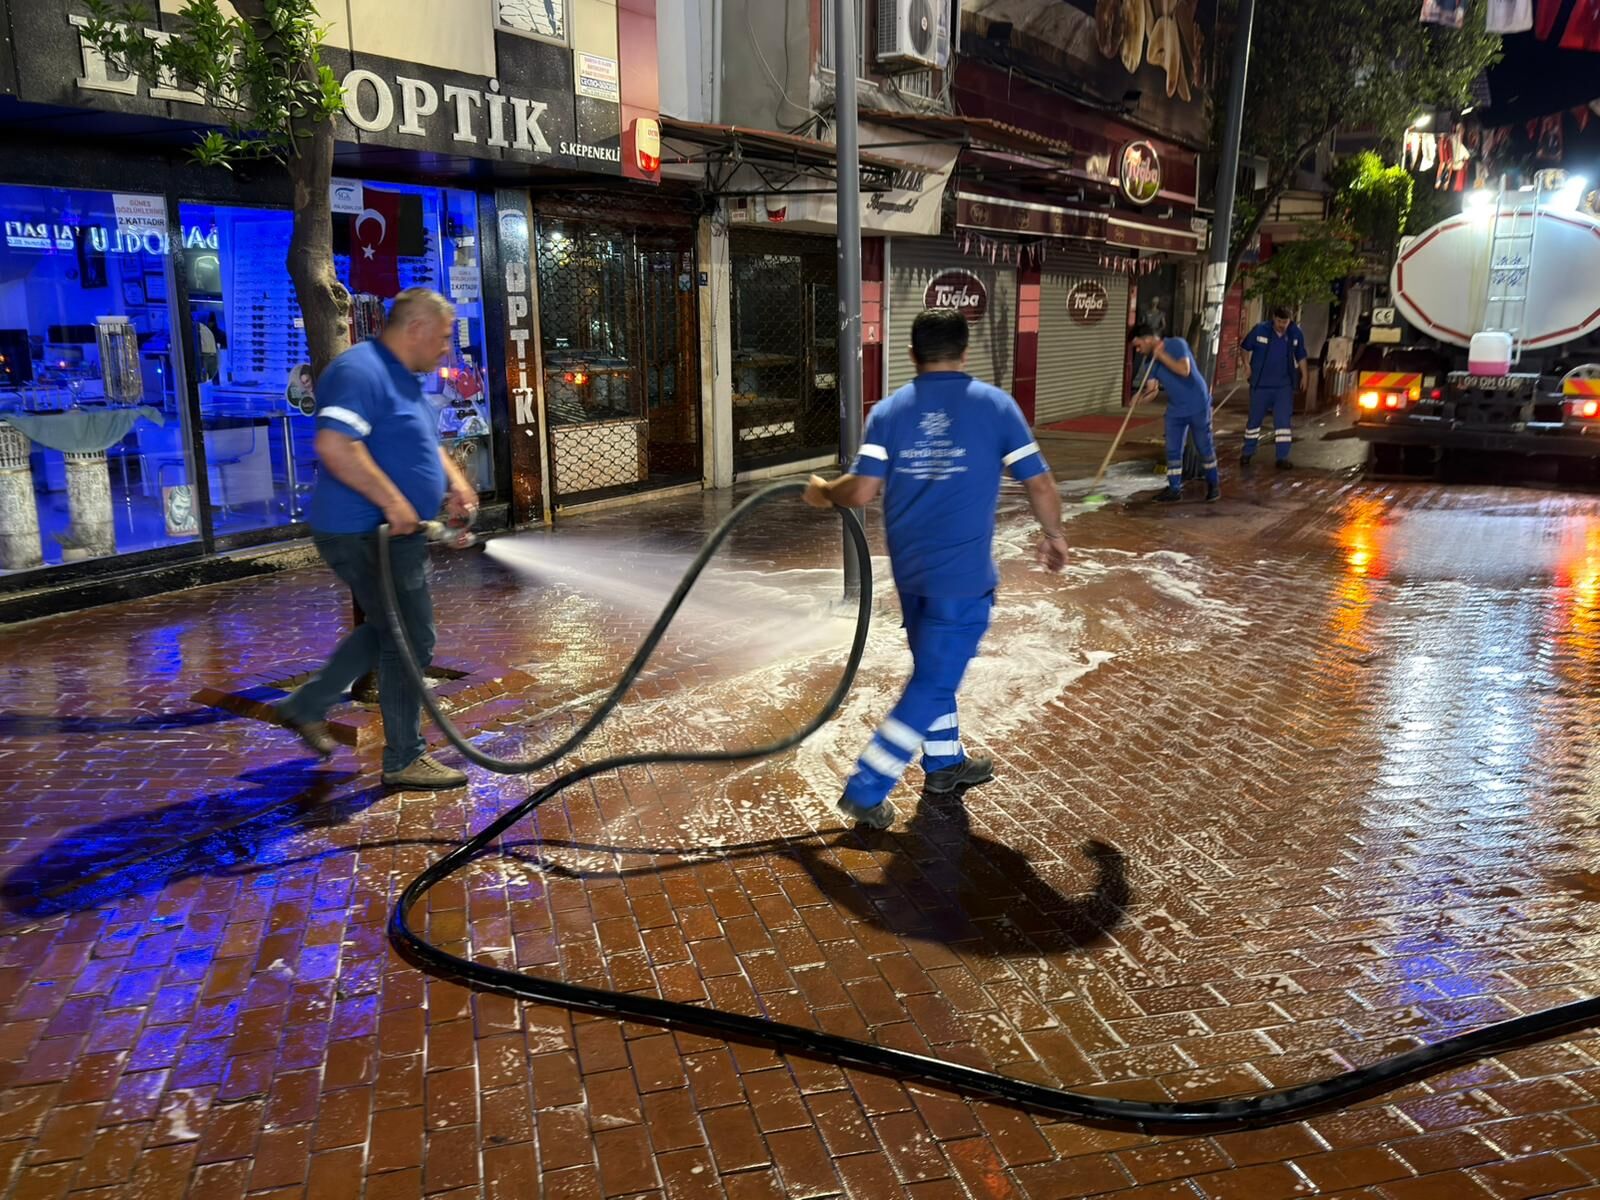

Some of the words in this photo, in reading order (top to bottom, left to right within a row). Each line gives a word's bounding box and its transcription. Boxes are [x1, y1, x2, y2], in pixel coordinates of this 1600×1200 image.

[342, 69, 552, 153] OPTİK
[559, 141, 621, 162] S.KEPENEKLİ
[118, 216, 165, 226] 2.KATTADIR
[935, 285, 980, 309] Tuğba
[1074, 293, 1103, 319] Tuğba
